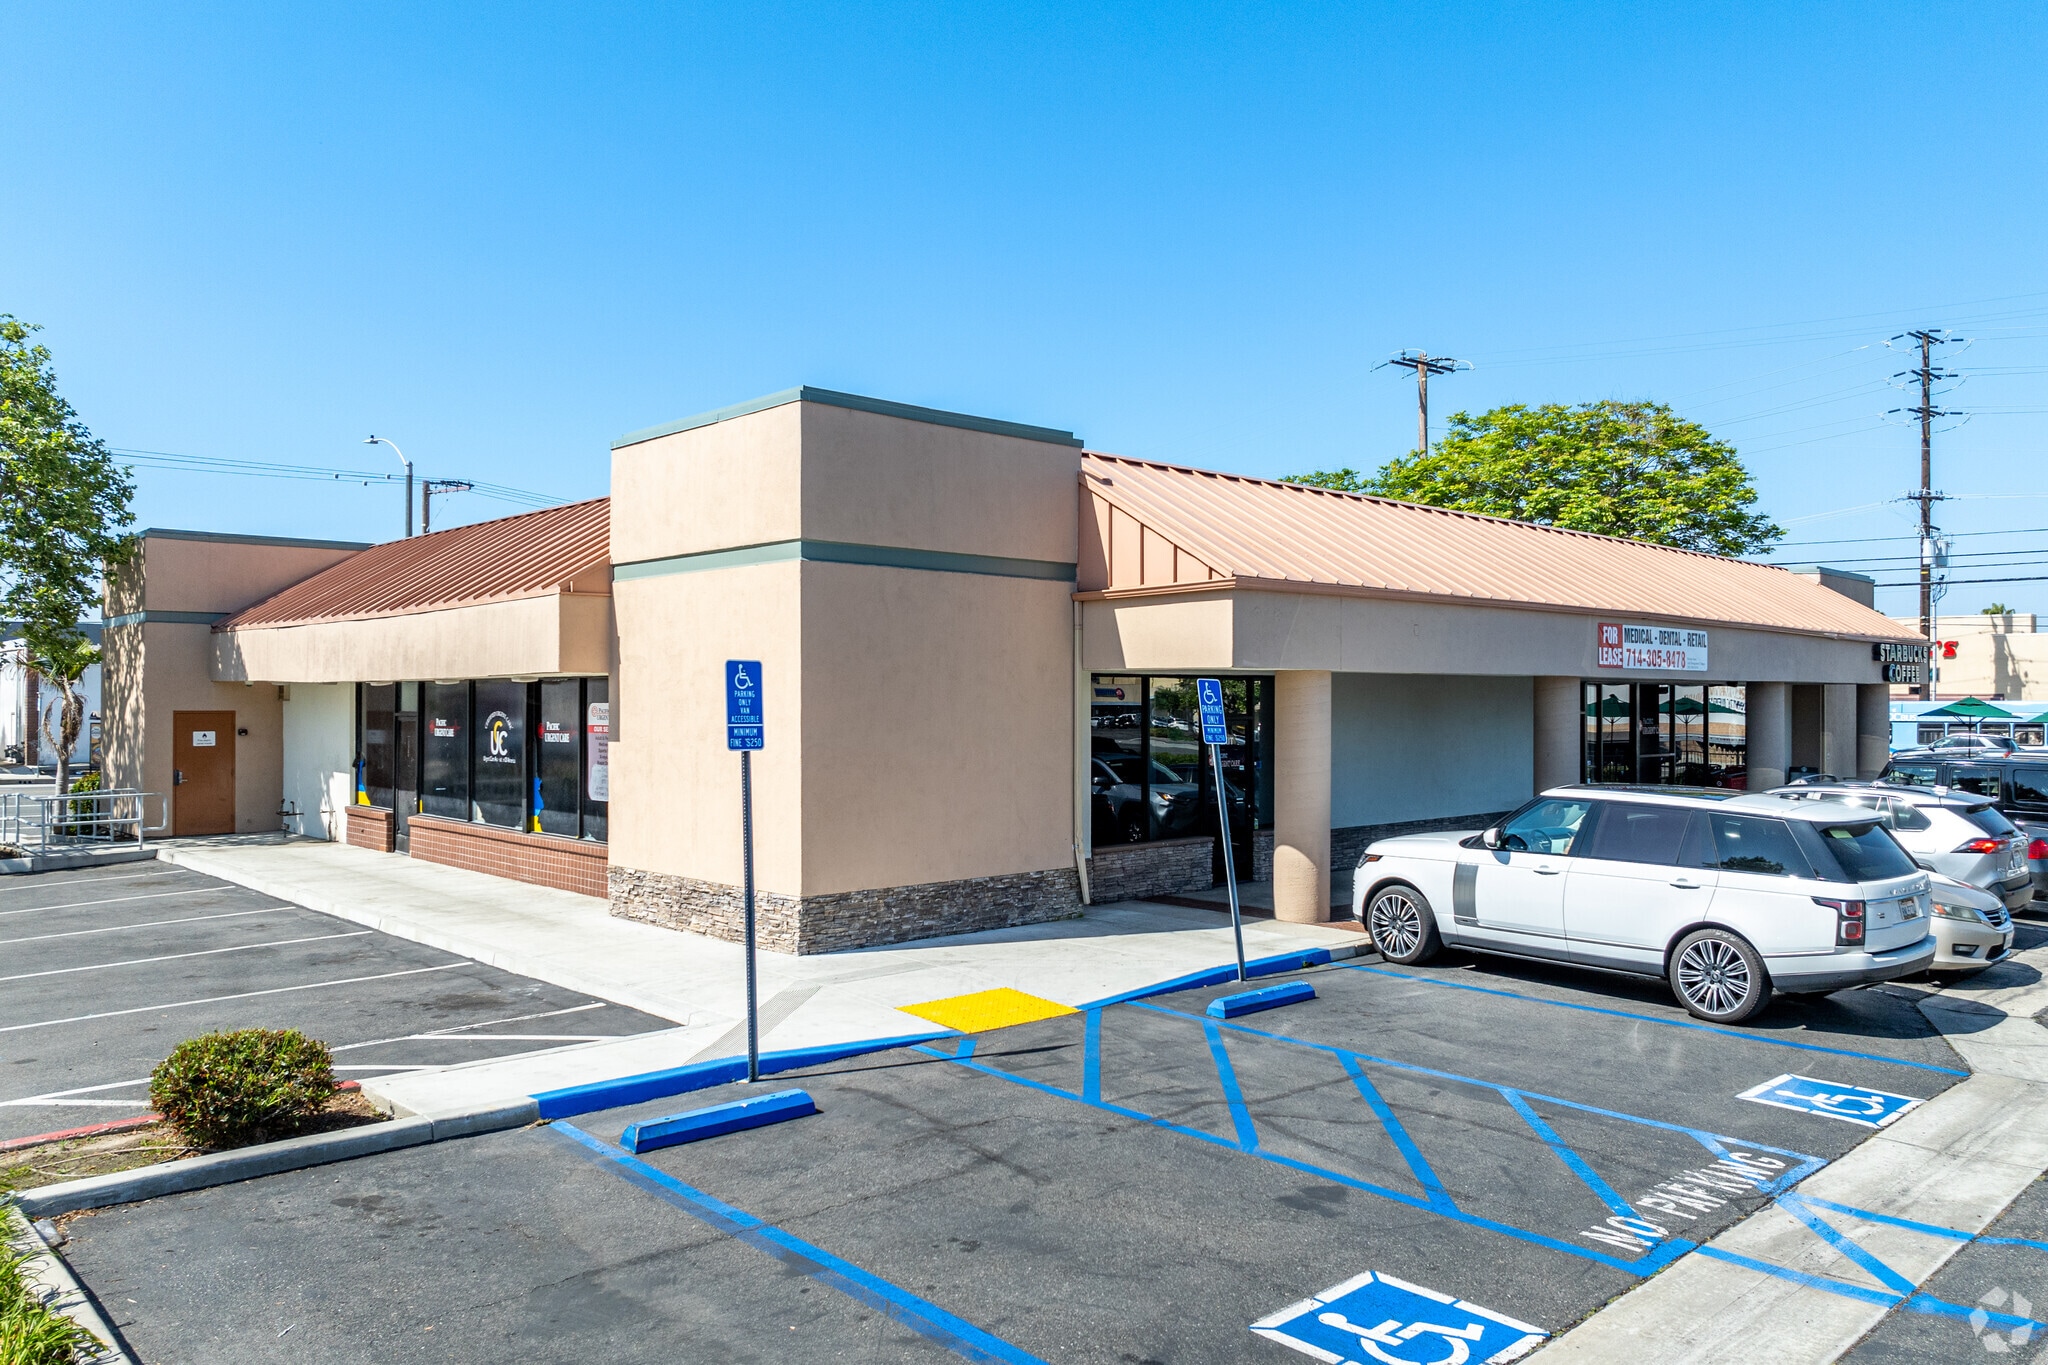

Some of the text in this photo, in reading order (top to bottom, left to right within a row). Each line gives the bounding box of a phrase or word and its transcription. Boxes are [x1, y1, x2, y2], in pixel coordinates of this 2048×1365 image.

[1603, 626, 1618, 644] FOR
[1624, 628, 1653, 644] MEDICAL
[1659, 630, 1682, 646] DENTAL
[1687, 632, 1707, 648] RETAIL
[1599, 647, 1623, 665] LEASE
[1626, 648, 1686, 668] 714-305-8478
[1880, 643, 1928, 663] STARBUCKS
[1889, 663, 1920, 682] COFFEE
[734, 690, 755, 698] PARKING
[738, 698, 751, 706] ONLY
[1202, 704, 1222, 714] PARKING
[731, 715, 760, 723] ACCESSIBLE
[1207, 715, 1219, 724] ONLY
[734, 728, 758, 736] MINIMUM
[730, 737, 762, 747] FINE $250
[1579, 1152, 1786, 1252] NO PARKING
